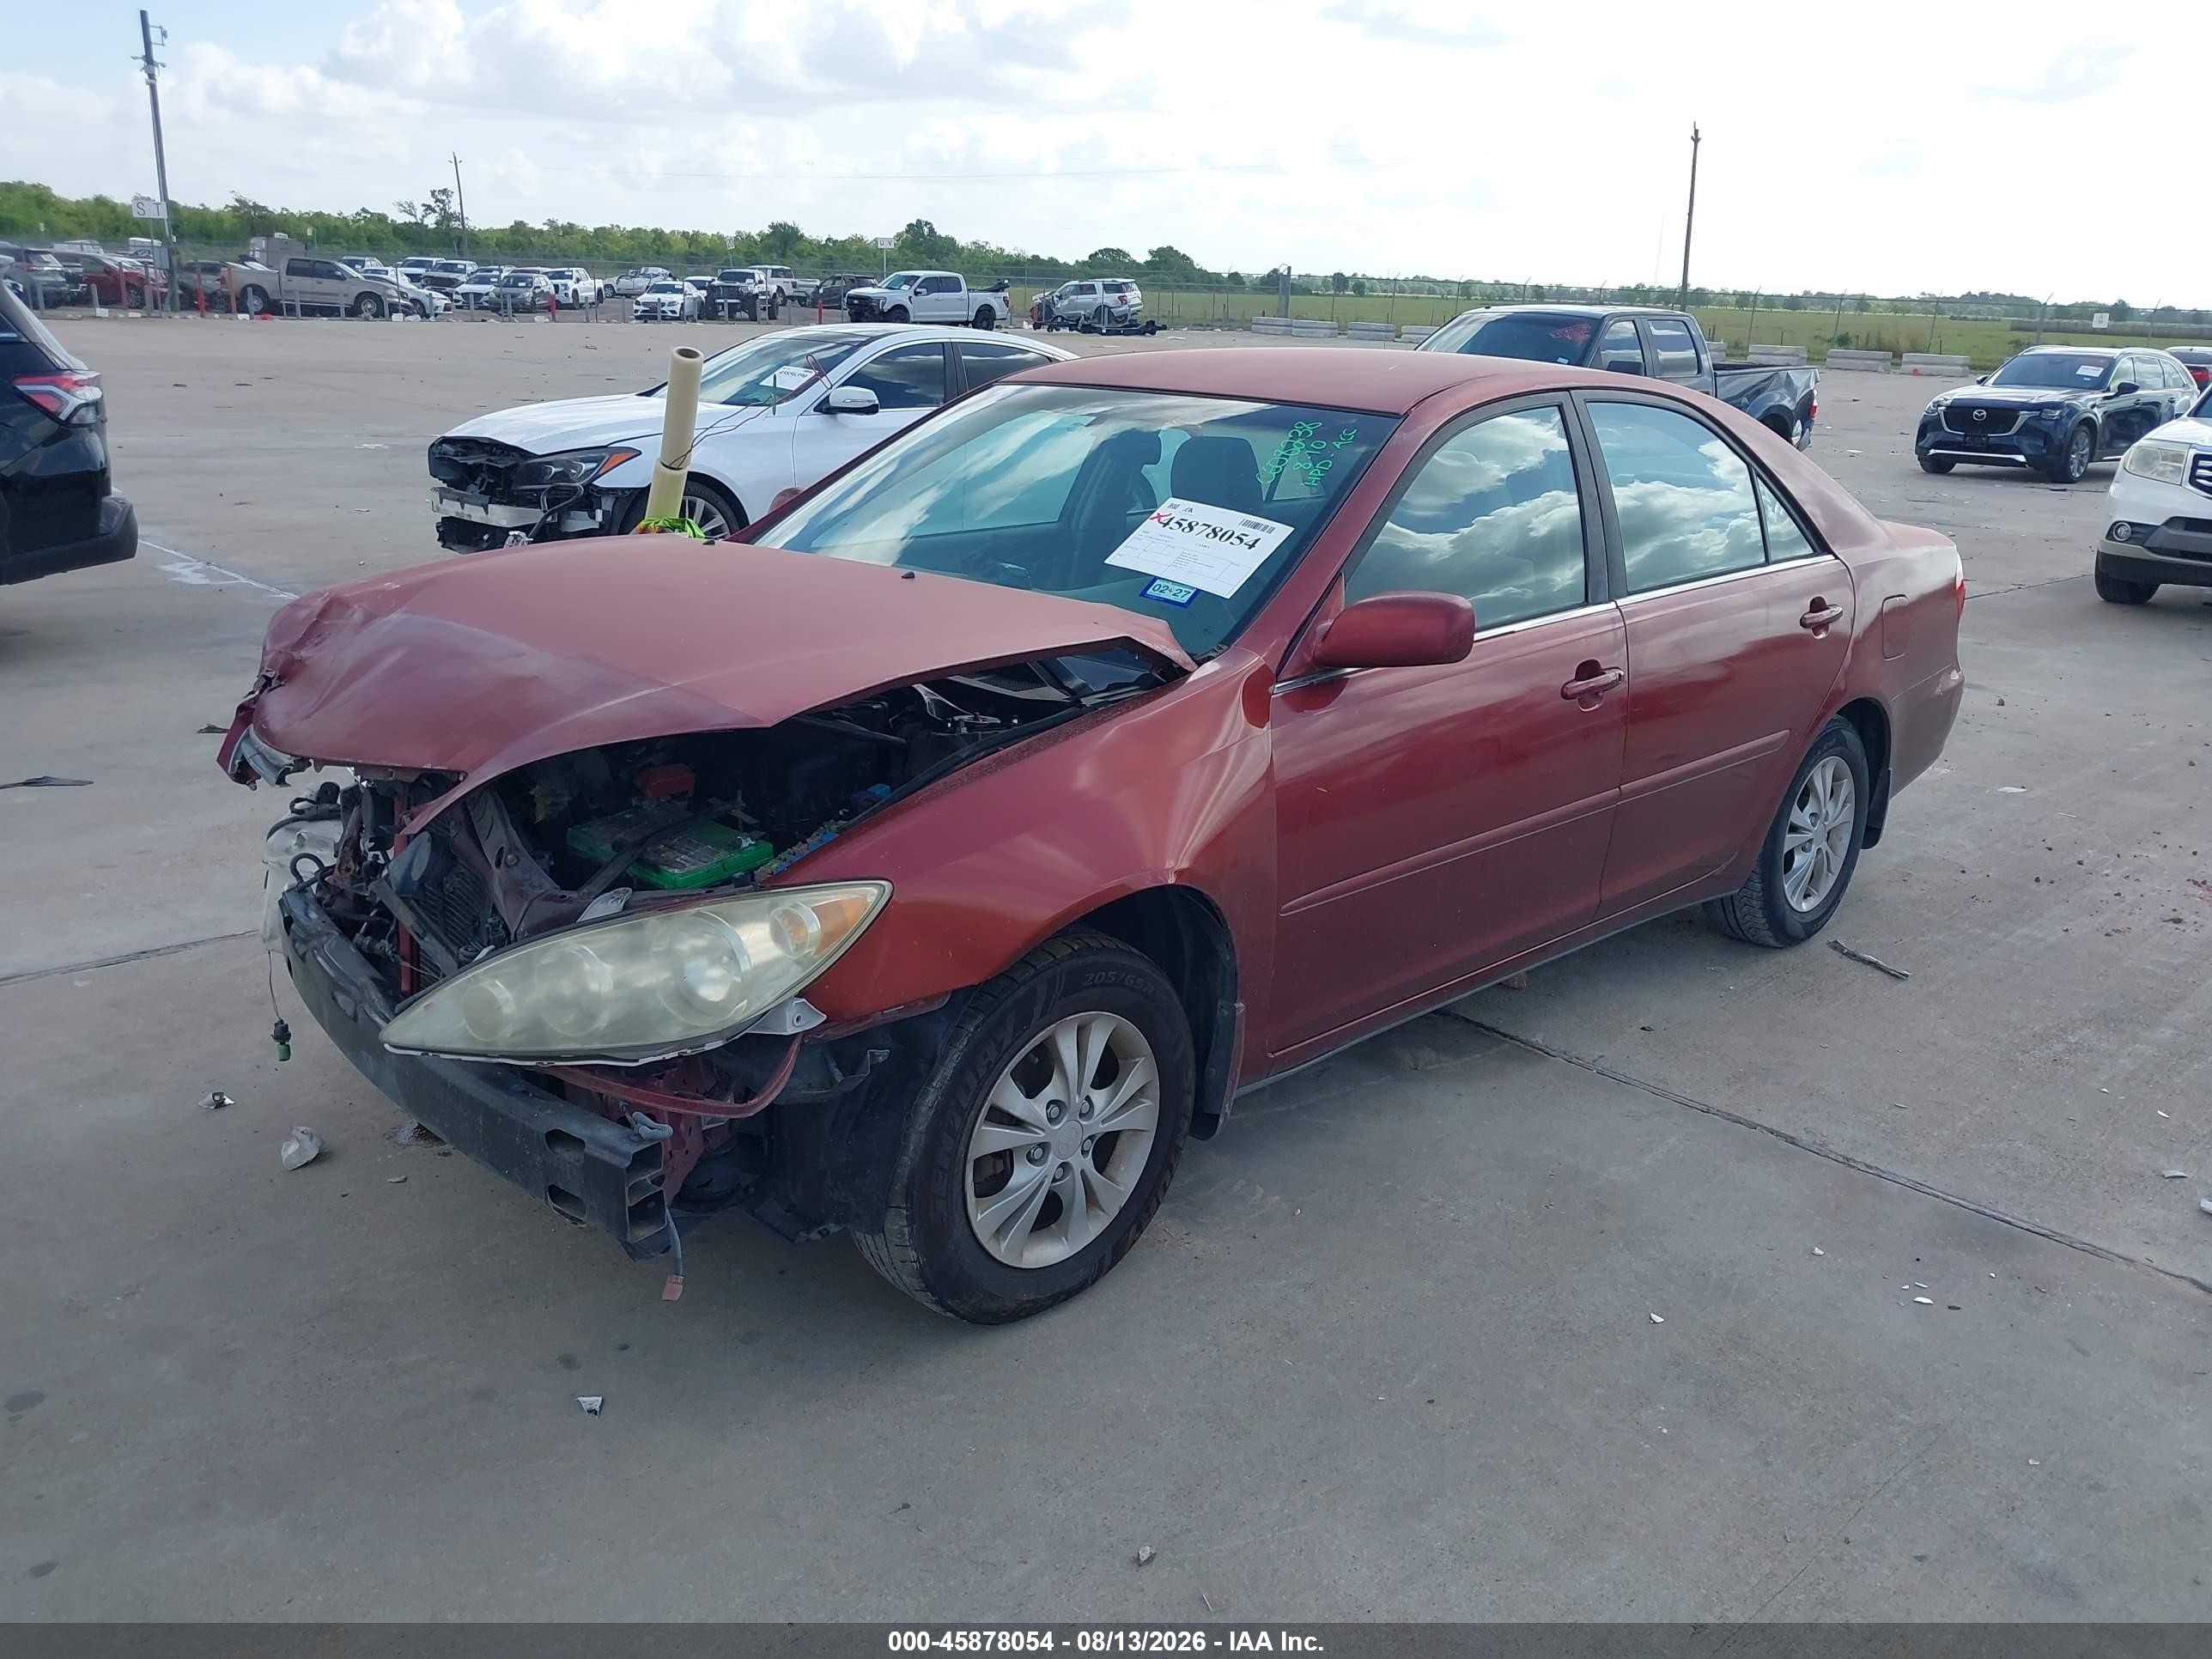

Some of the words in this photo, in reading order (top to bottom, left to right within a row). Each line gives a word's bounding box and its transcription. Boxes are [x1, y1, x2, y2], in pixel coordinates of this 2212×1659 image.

[137, 202, 146, 216] S
[152, 203, 161, 216] T
[1158, 515, 1262, 550] 45878054
